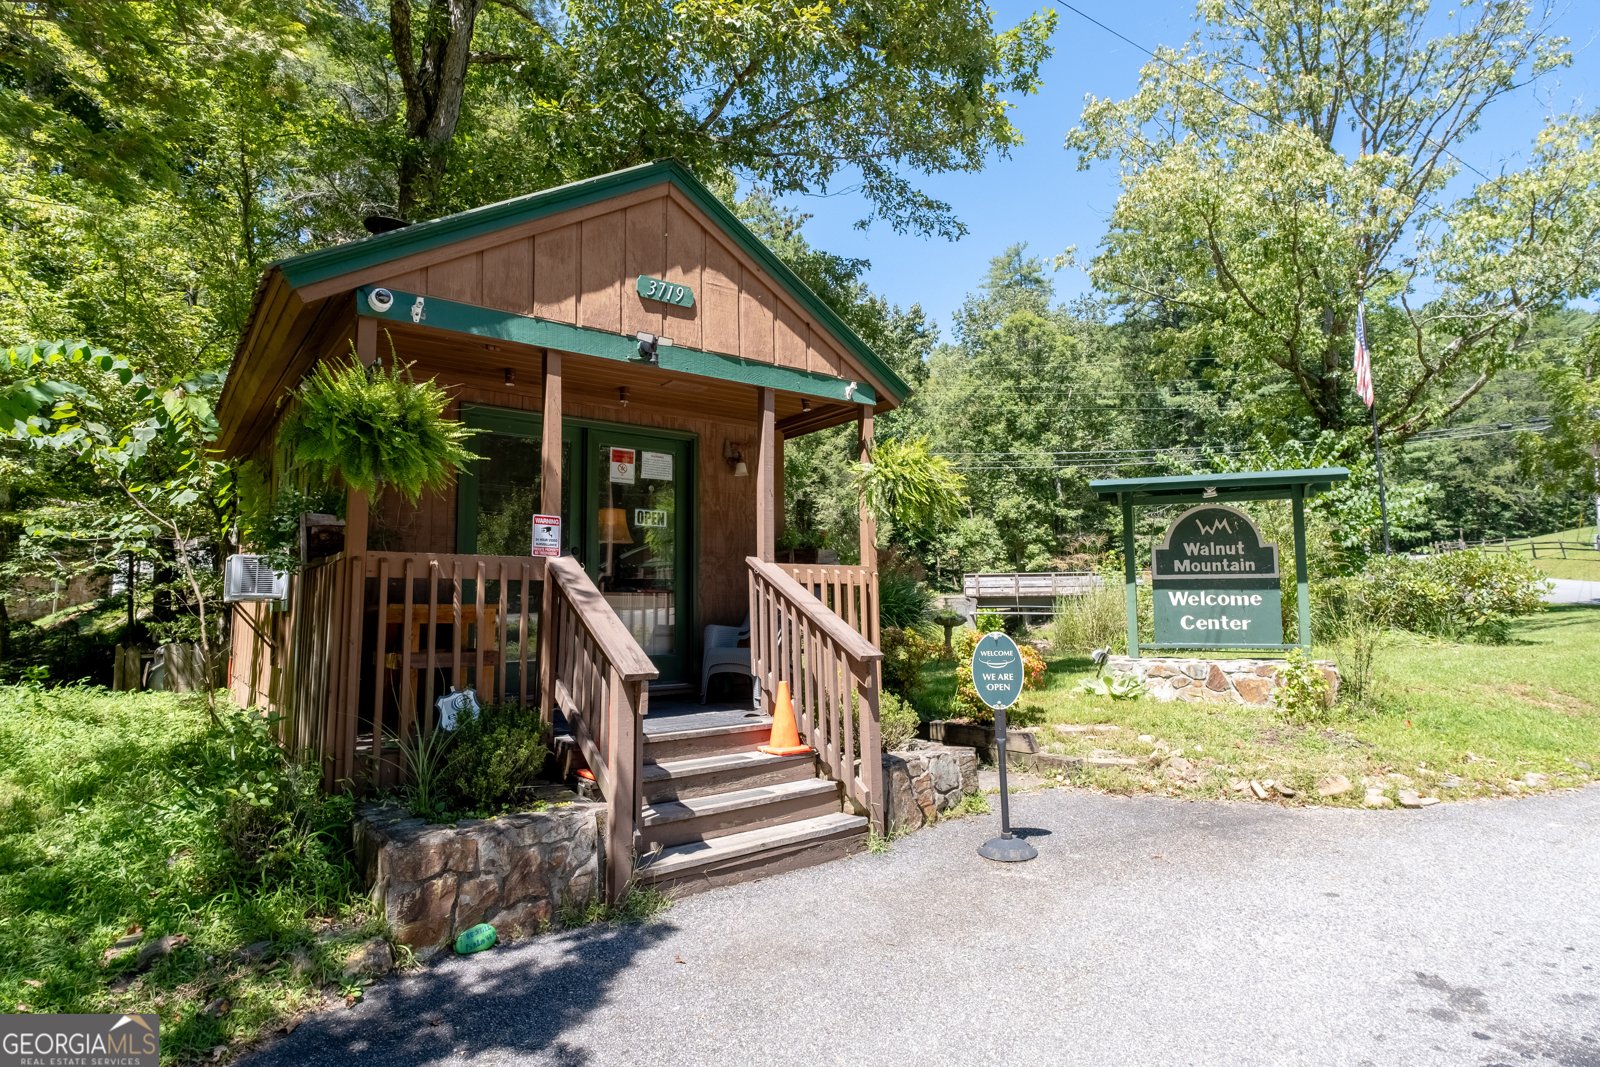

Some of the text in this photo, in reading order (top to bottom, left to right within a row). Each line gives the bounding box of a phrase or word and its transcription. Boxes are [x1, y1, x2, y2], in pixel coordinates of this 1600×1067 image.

[647, 280, 684, 302] 3719
[535, 517, 559, 525] WARNING
[637, 510, 665, 526] OPEN
[1183, 541, 1245, 556] Walnut
[1173, 558, 1256, 572] Mountain
[1168, 590, 1263, 606] Welcome
[1180, 615, 1251, 631] Center
[982, 673, 1014, 681] WE ARE
[986, 683, 1011, 691] OPEN
